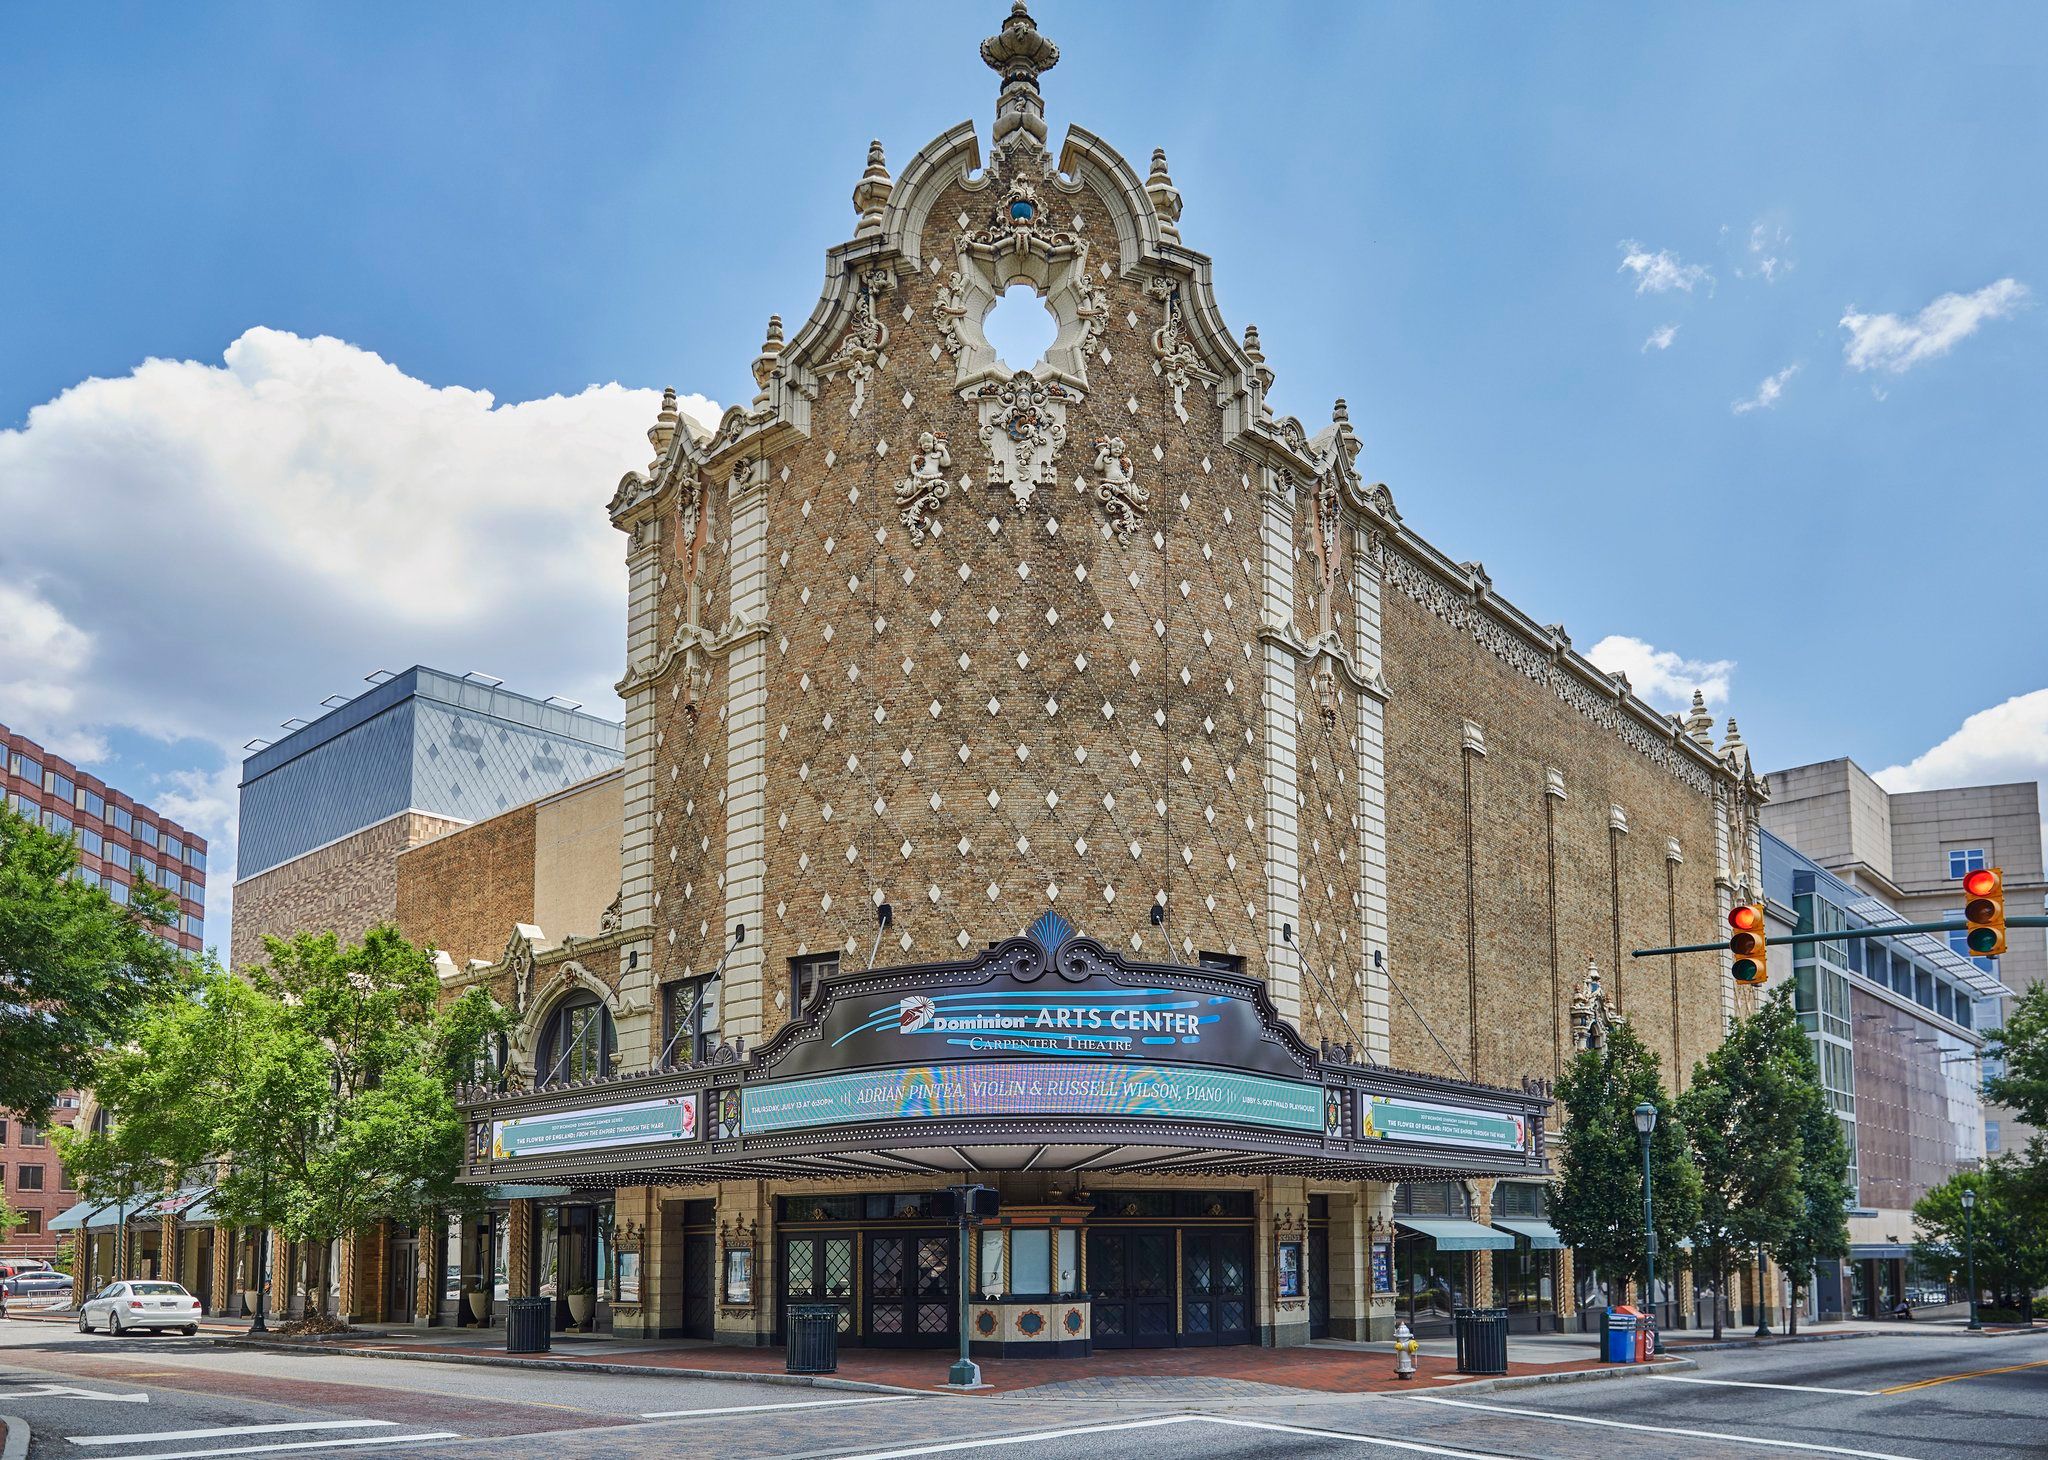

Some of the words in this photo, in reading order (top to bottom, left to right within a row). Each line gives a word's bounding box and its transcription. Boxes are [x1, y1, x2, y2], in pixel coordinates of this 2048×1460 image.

[933, 1013, 1025, 1031] Dominion
[1034, 1007, 1102, 1029] ARTS
[1110, 1009, 1200, 1035] CENTER
[856, 1085, 906, 1104] ADRIAN
[909, 1082, 966, 1100] PINTEA,
[972, 1080, 1026, 1098] VIOLIN
[1029, 1081, 1043, 1096] &
[1047, 1080, 1118, 1096] RUSSELL
[1122, 1081, 1182, 1101] WILSON,
[1186, 1085, 1222, 1103] PIANO
[781, 1102, 795, 1111] JULY
[796, 1101, 803, 1109] 13
[616, 1125, 640, 1133] THROUGH
[1387, 1119, 1397, 1127] THE
[1397, 1121, 1415, 1129] FLOWER
